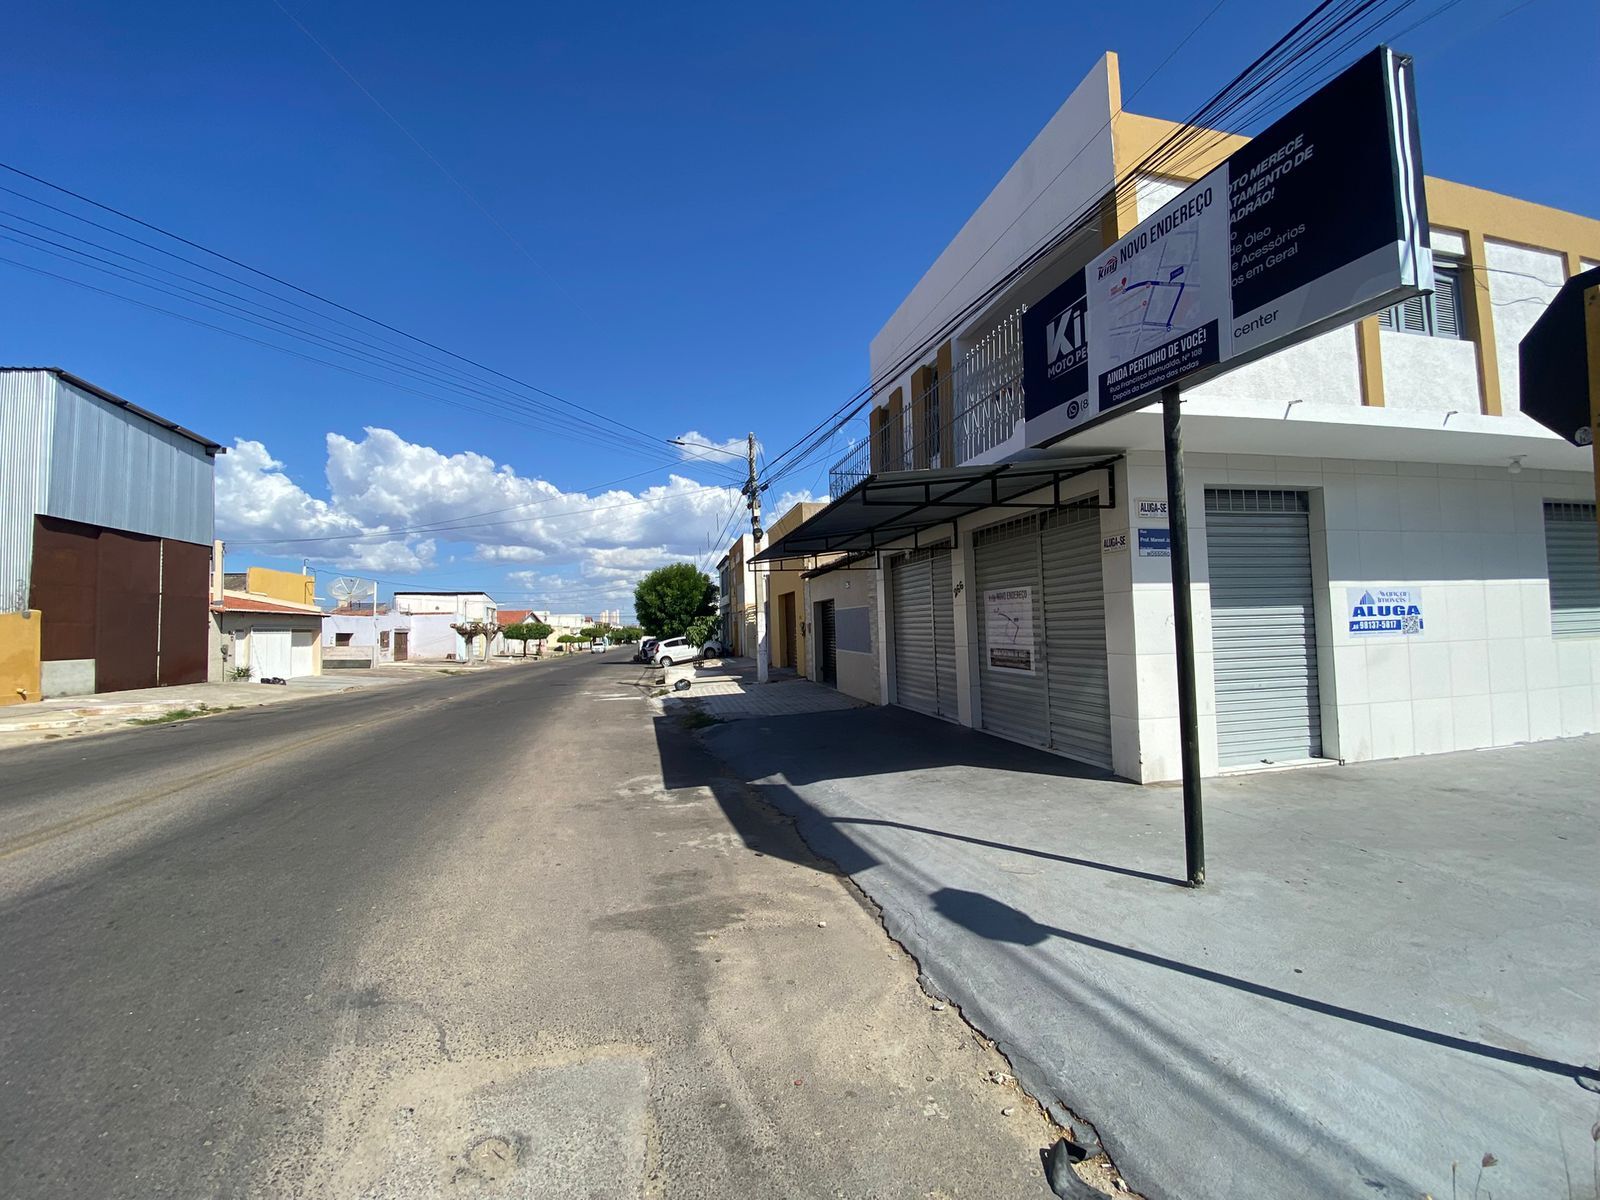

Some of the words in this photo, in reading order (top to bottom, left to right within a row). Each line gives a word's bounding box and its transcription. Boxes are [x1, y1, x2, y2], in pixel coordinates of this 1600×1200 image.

[1249, 133, 1304, 181] MERECE
[1294, 144, 1314, 168] DE
[1120, 232, 1147, 264] NOVO
[1150, 187, 1213, 243] ENDEREÇO
[1244, 226, 1272, 247] Óleo
[1232, 262, 1239, 271] e
[1240, 223, 1306, 267] Acessórios
[1245, 264, 1264, 279] em
[1266, 242, 1299, 268] Geral
[1233, 309, 1279, 338] center
[1048, 355, 1074, 379] MOTO
[1075, 346, 1088, 363] PE
[1106, 367, 1128, 386] AINDA
[1129, 350, 1167, 377] PERTINHO
[1168, 342, 1180, 357] DE
[1180, 328, 1207, 352] VOCÊ!
[1110, 385, 1120, 393] Rua
[1112, 389, 1131, 401] Depois
[1179, 359, 1199, 374] rodas
[1140, 502, 1167, 513] ALUGA-SE
[1103, 536, 1126, 548] ALUGA-SE
[1352, 605, 1420, 617] ALUGA
